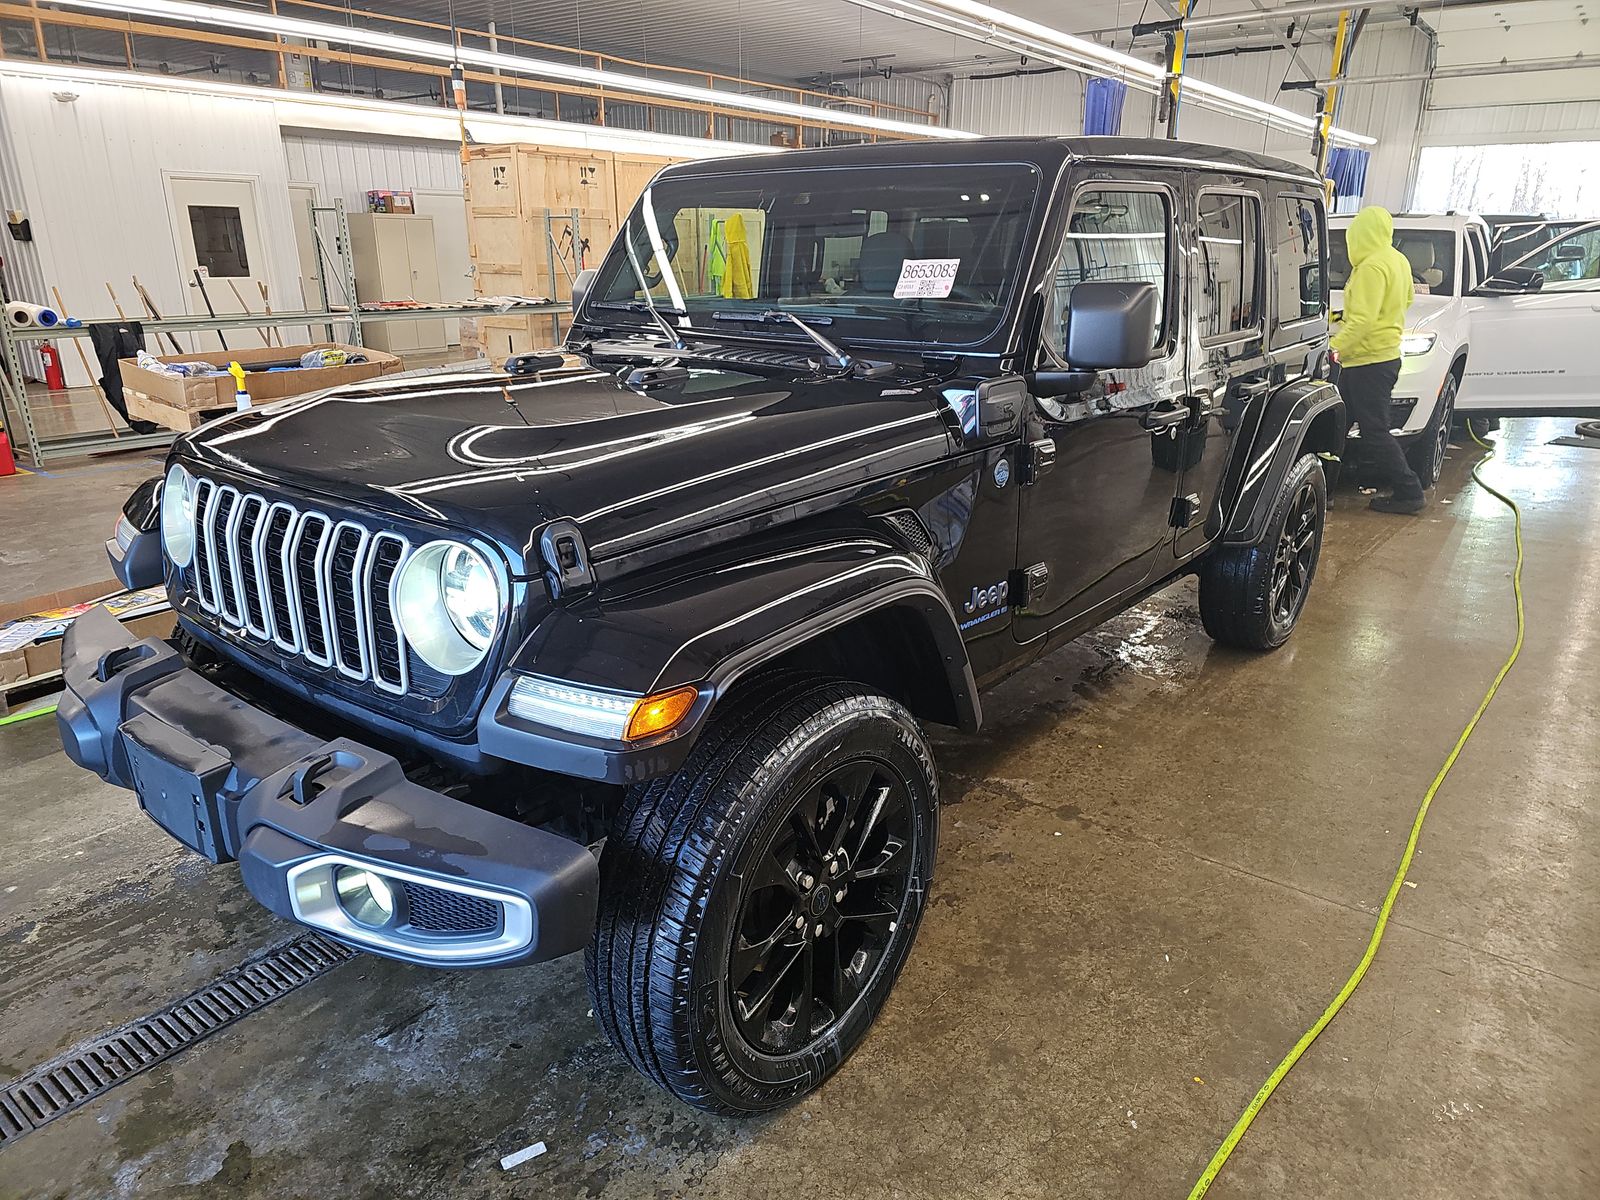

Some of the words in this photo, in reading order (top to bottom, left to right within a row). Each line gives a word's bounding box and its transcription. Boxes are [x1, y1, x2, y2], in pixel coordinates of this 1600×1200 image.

[903, 263, 958, 279] 8653083
[963, 580, 1009, 614] Jeep
[960, 608, 1001, 631] WRANGLER
